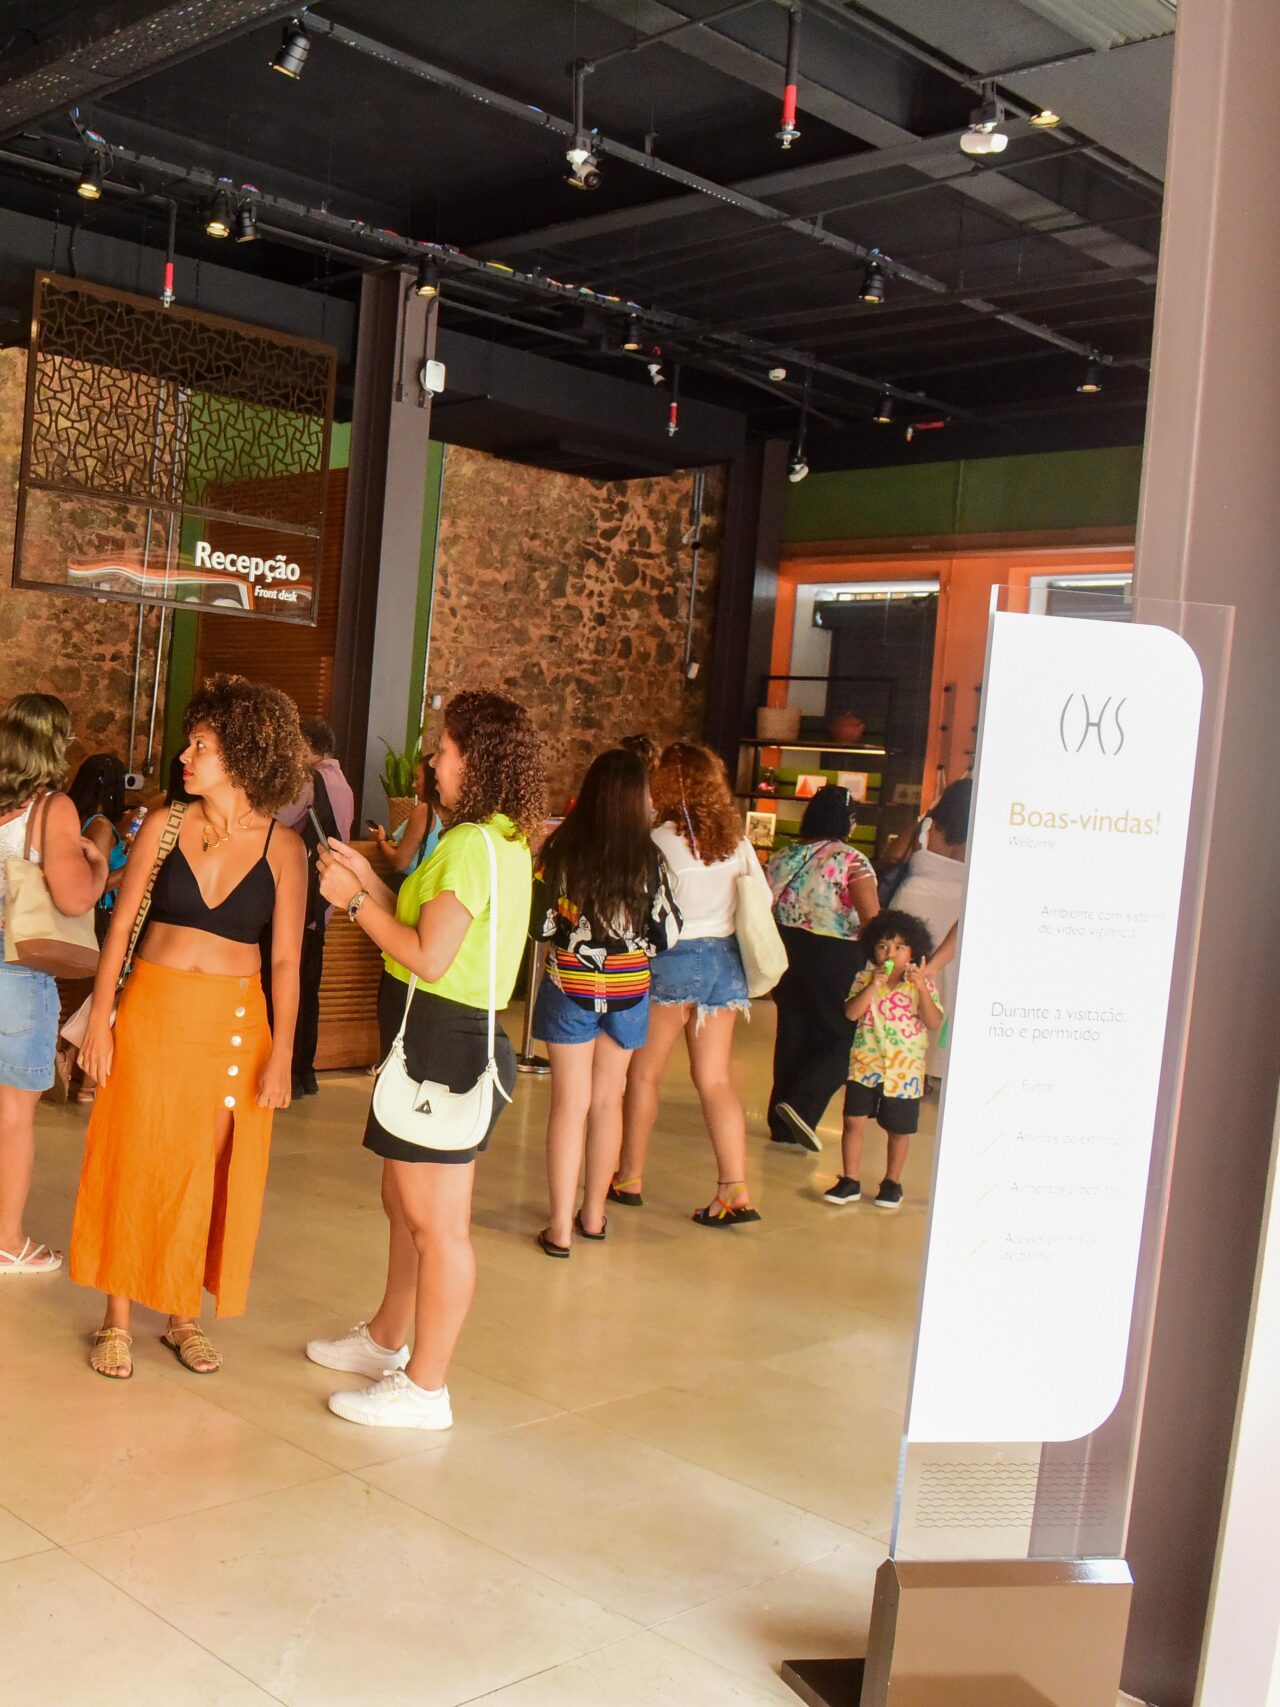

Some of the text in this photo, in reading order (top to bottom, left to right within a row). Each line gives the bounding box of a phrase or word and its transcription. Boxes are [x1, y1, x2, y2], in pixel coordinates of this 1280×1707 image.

[195, 541, 301, 582] Recepção
[254, 586, 298, 603] Front desk
[1008, 801, 1162, 836] Boas-vindas!
[1008, 835, 1056, 850] Welcome
[991, 1001, 1050, 1020] Durante
[1054, 1009, 1061, 1020] a
[987, 1023, 1015, 1038] não
